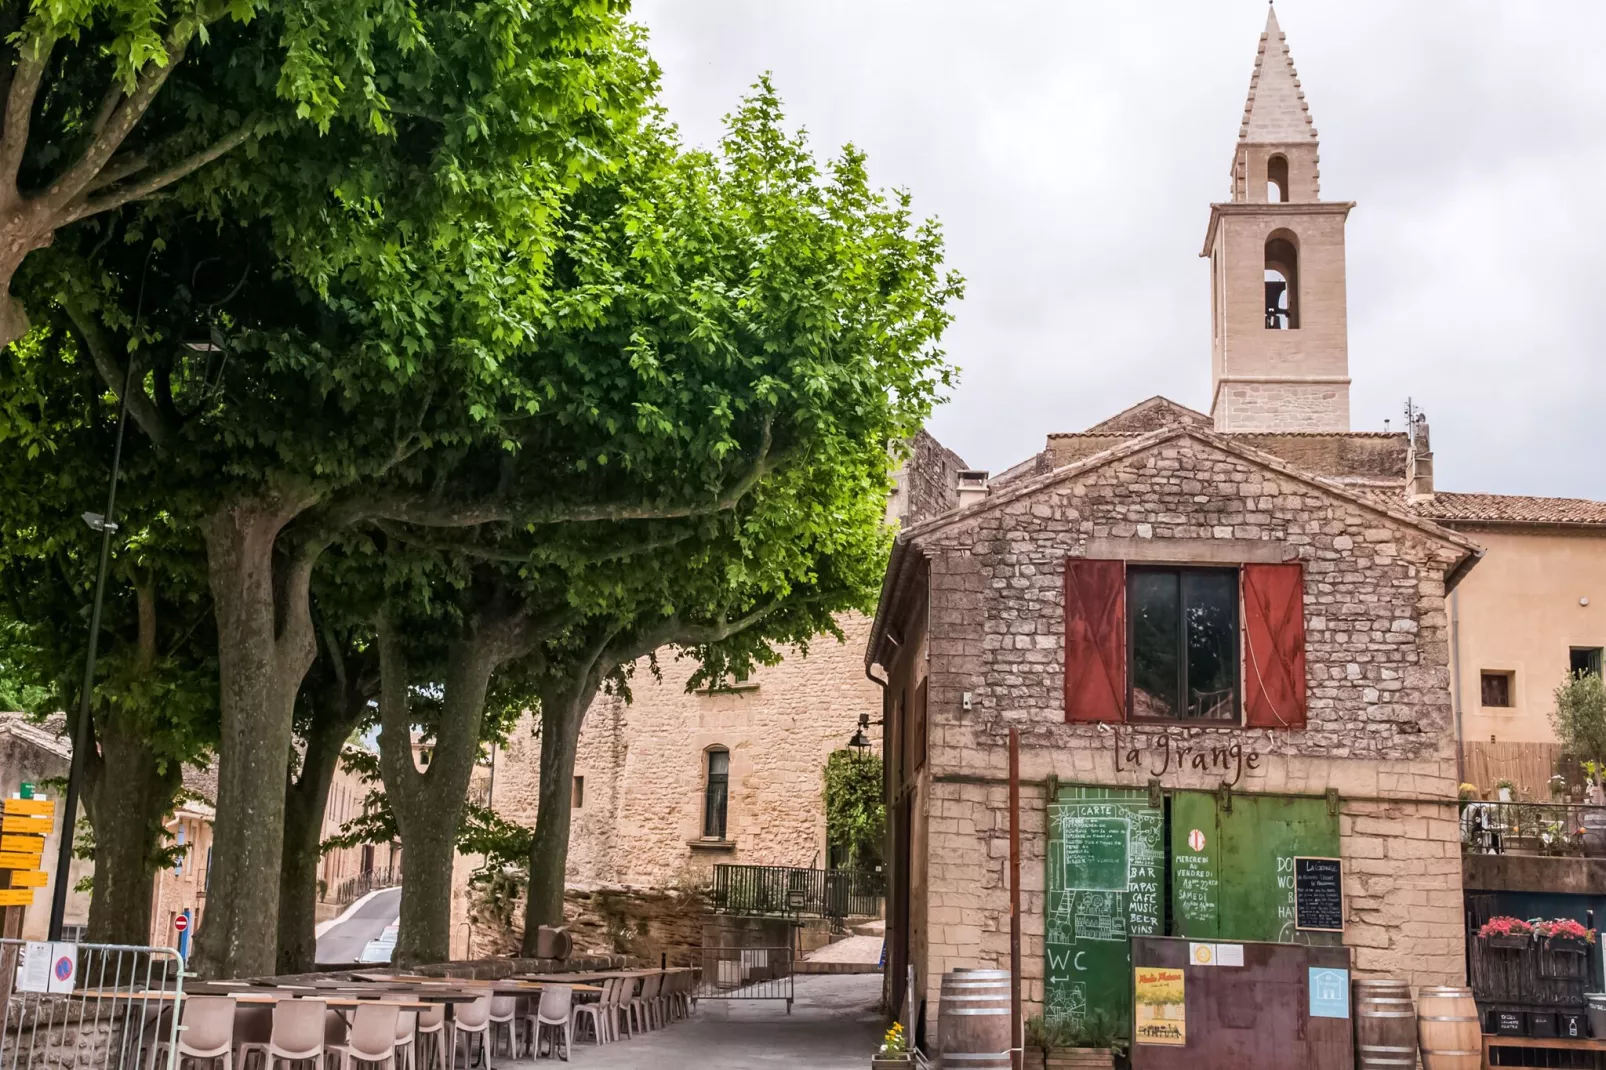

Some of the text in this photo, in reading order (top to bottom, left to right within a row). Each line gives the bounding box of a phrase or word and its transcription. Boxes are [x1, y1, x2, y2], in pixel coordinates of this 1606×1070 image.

[1150, 734, 1260, 787] grange
[1081, 806, 1112, 816] CARTE
[1277, 857, 1293, 873] DO
[1130, 867, 1156, 878] BAR
[1129, 882, 1158, 892] TAPAS
[1130, 913, 1159, 926] BEER
